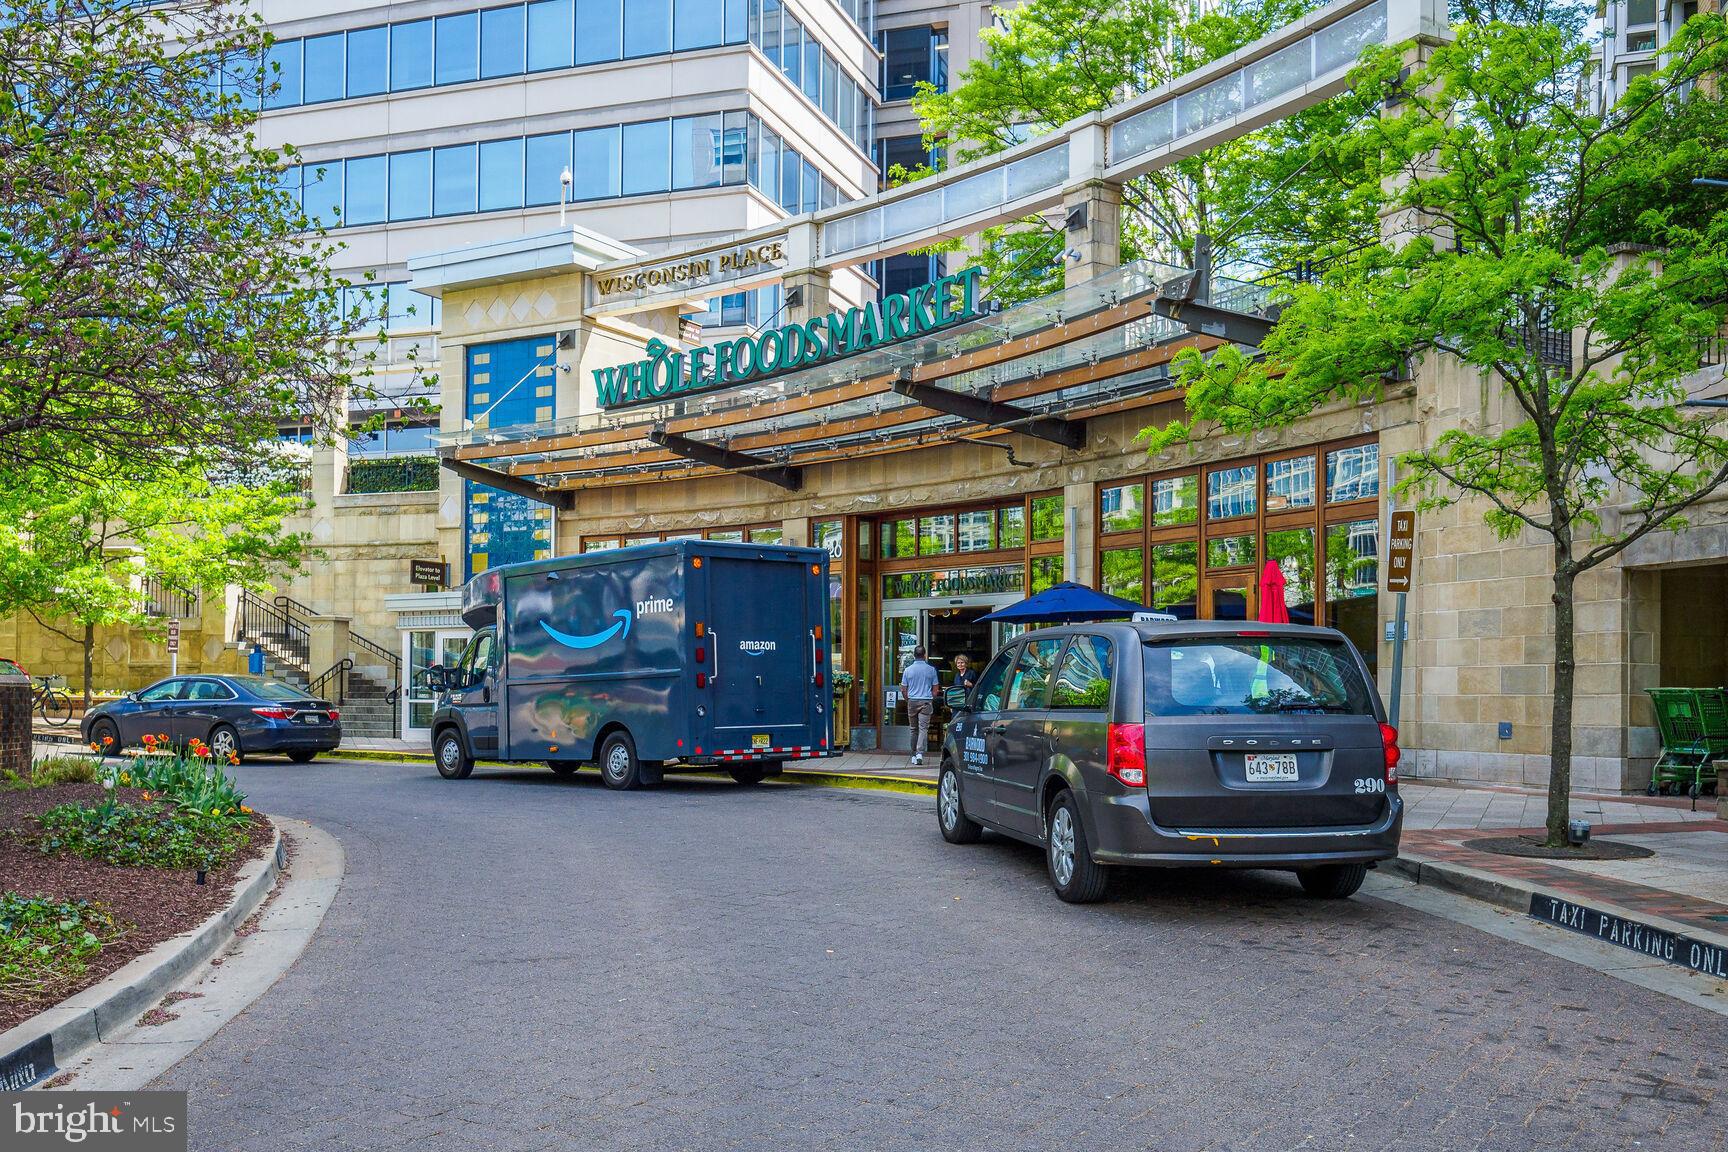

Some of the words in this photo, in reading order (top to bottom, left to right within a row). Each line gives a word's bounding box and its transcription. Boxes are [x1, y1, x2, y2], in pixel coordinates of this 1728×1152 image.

[598, 259, 711, 296] WISCONSIN
[719, 243, 783, 273] PLACE
[591, 337, 710, 406] WHOLE
[713, 316, 826, 382] FOODS
[826, 266, 986, 354] MARKET
[1396, 520, 1408, 532] TAXI
[1391, 538, 1412, 550] PARKING
[415, 565, 434, 573] Elevator
[1393, 556, 1407, 569] ONLY
[636, 596, 674, 619] prime
[739, 640, 776, 651] amazon
[1249, 761, 1269, 775] 643
[1275, 760, 1296, 775] 78B
[1354, 777, 1385, 793] 290
[1549, 899, 1587, 930] TAXI
[1598, 914, 1675, 960] PARKING
[1690, 943, 1727, 977] ONL
